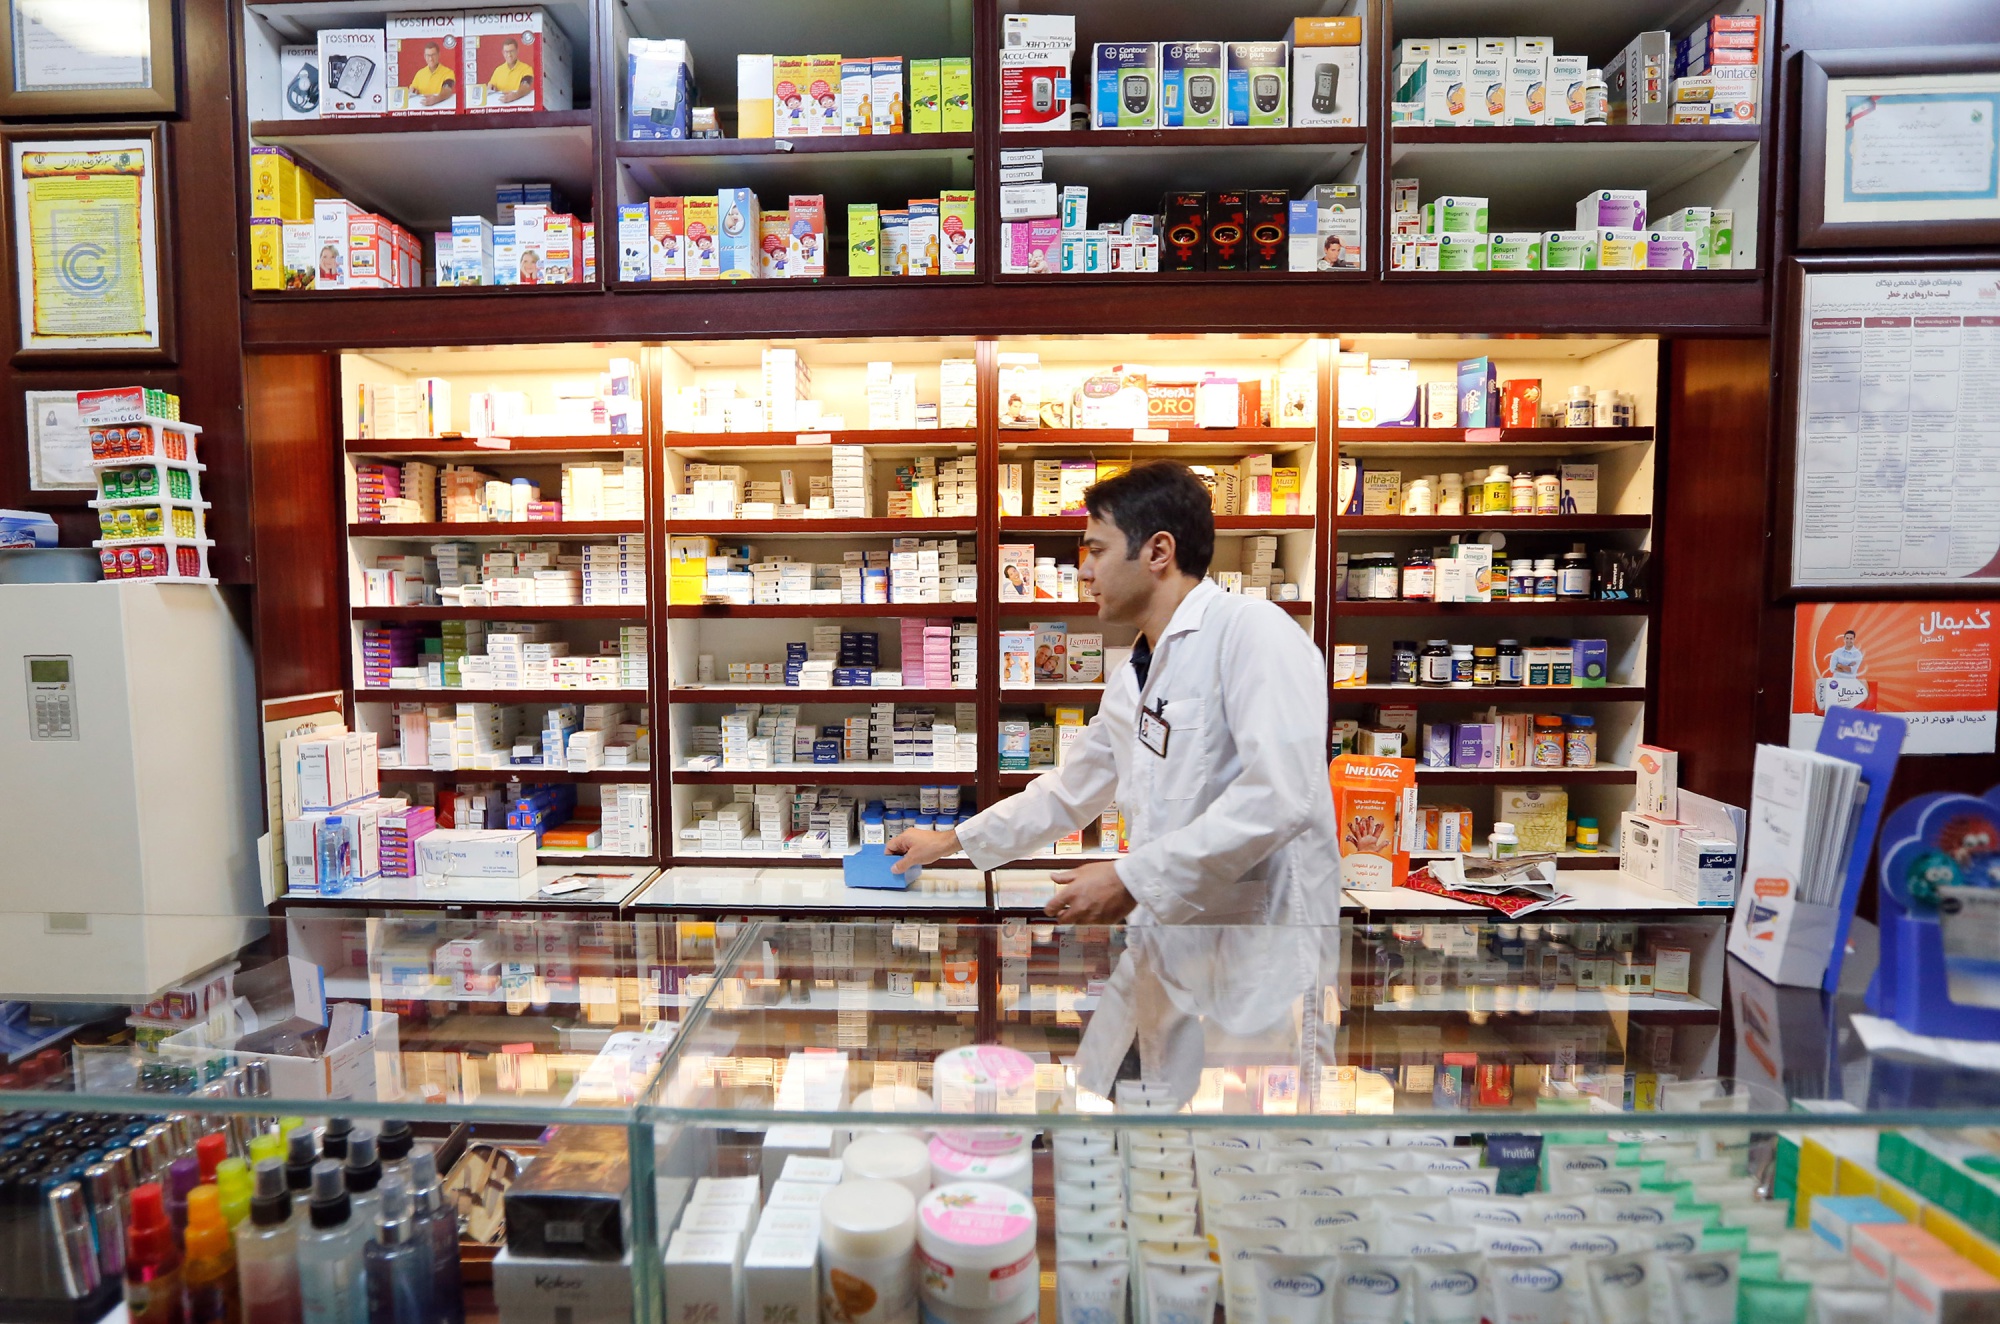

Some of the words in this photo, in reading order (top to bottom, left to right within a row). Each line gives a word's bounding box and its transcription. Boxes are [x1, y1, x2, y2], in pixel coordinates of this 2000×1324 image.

[394, 16, 455, 28] rossmax
[473, 11, 533, 25] rossmax
[1730, 20, 1756, 28] Jointace
[326, 33, 376, 44] rossmax
[1730, 37, 1754, 45] Jointace
[1119, 46, 1148, 54] Contour
[1002, 52, 1049, 60] ACCU-CHEK
[1184, 52, 1200, 60] plus
[1250, 52, 1265, 60] plus
[1432, 68, 1455, 76] Omega
[1472, 68, 1495, 76] Omega
[1512, 68, 1535, 76] Omega
[1630, 50, 1638, 120] rossmax
[1682, 78, 1712, 86] rossmax
[1300, 118, 1340, 126] CareSens
[1006, 170, 1035, 178] rossmax
[1493, 246, 1519, 254] Sinupret
[1894, 279, 1917, 288] تخصصی
[1933, 279, 1962, 287] بیمارستان
[1886, 290, 1900, 300] خطر
[1909, 290, 1933, 299] داروهای
[1935, 290, 1950, 298] لیست
[1148, 387, 1194, 399] SiderAL
[1148, 400, 1194, 413] ORO
[1043, 635, 1062, 644] Mg7
[1069, 638, 1100, 646] Isomax
[1920, 635, 1944, 644] اکسترا
[1345, 762, 1399, 778] INFLUVAC
[1502, 1148, 1535, 1160] fruttini
[1347, 1274, 1392, 1288] dulgon
[1511, 1272, 1554, 1286] dulgon
[1273, 1278, 1317, 1291] dulgon
